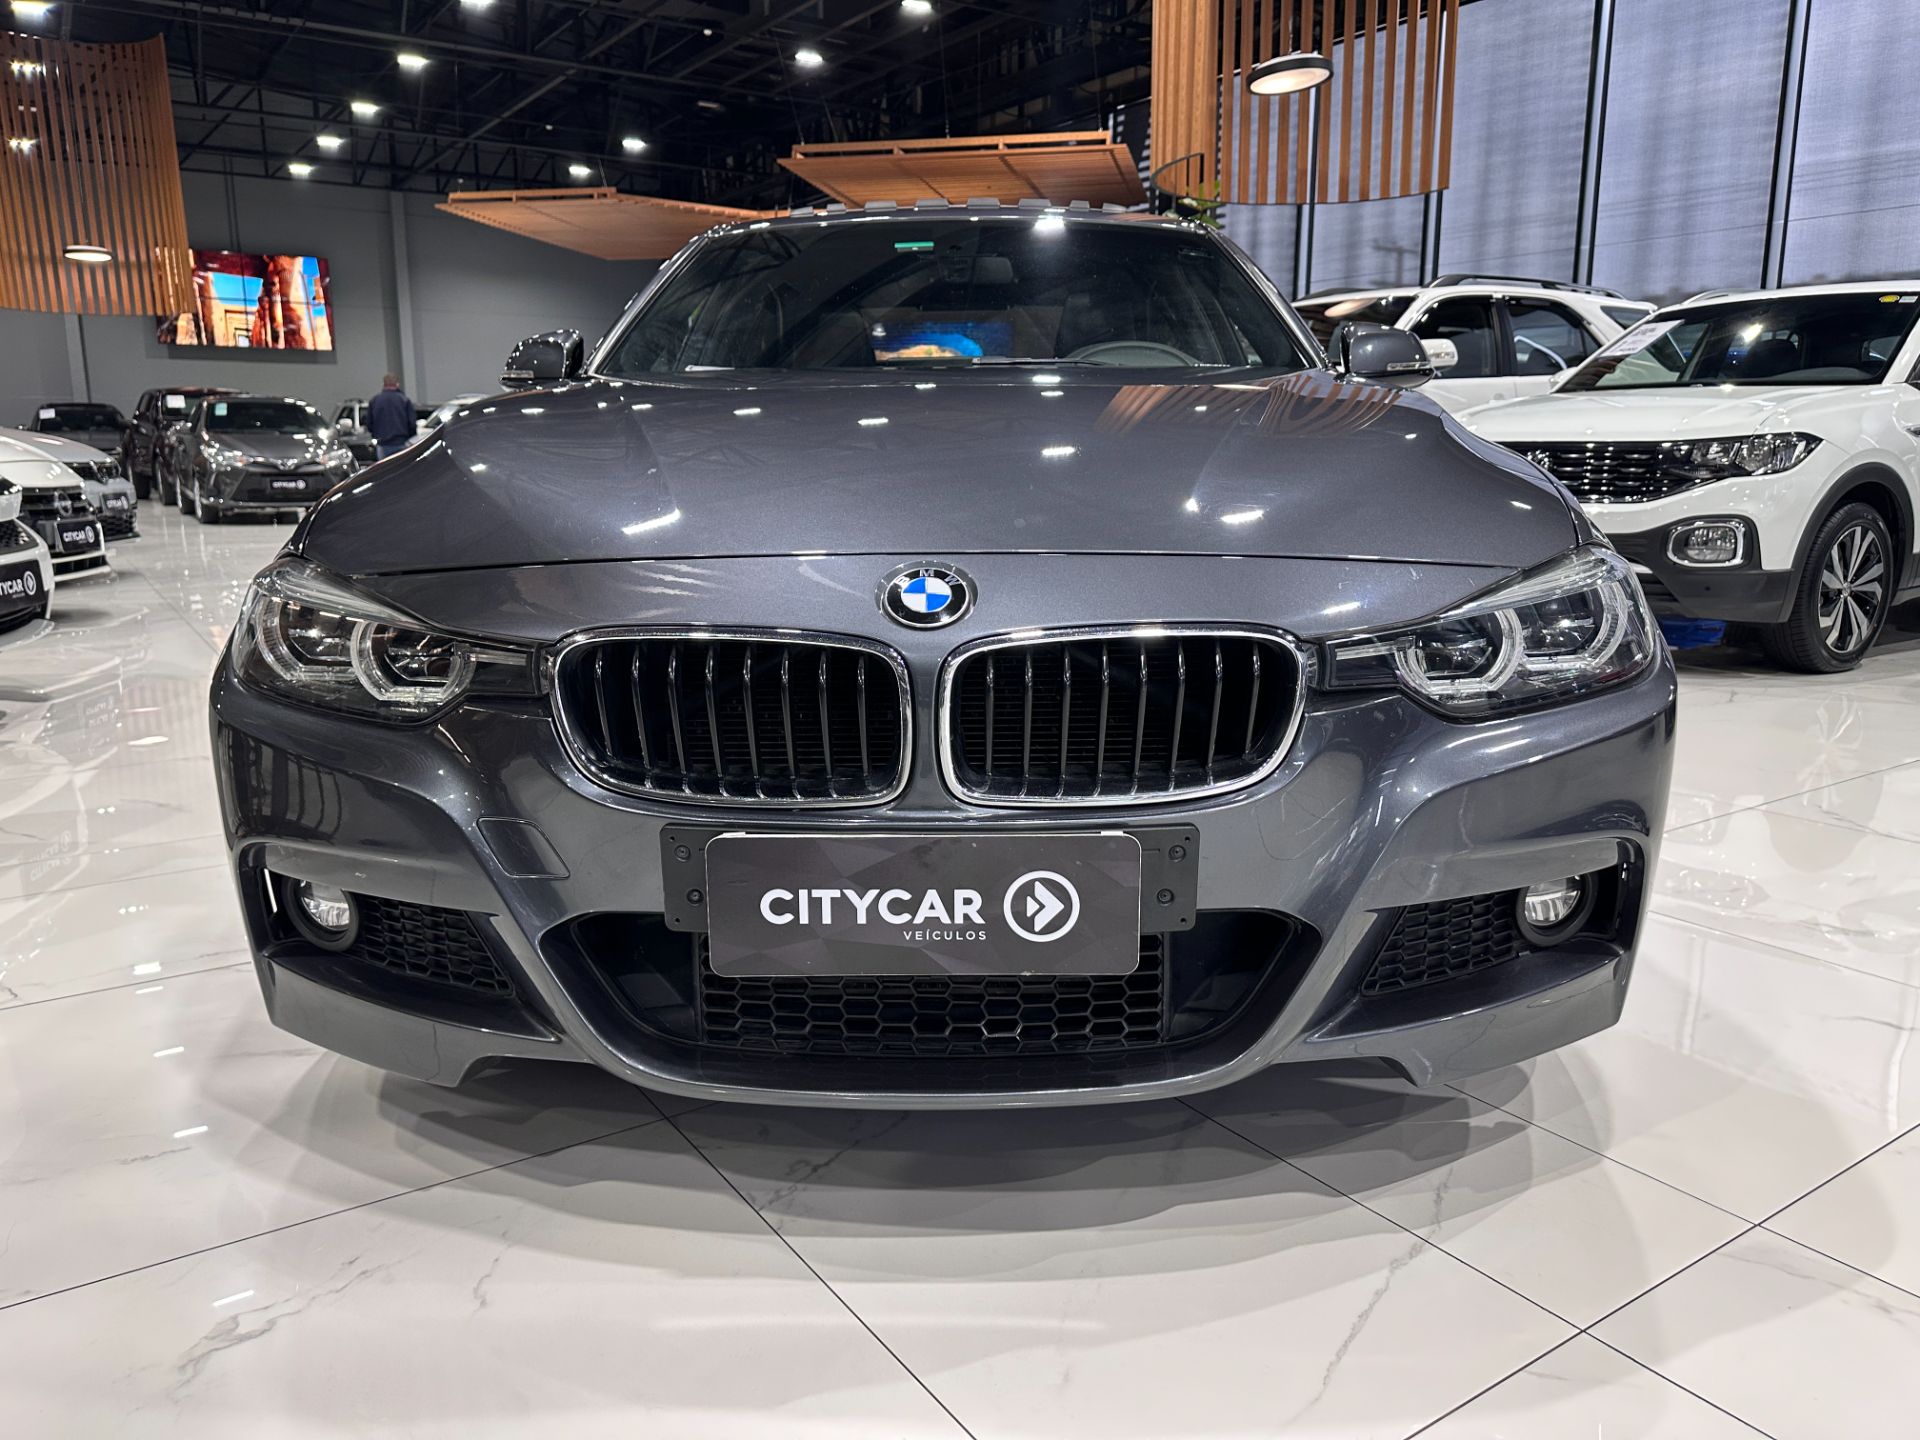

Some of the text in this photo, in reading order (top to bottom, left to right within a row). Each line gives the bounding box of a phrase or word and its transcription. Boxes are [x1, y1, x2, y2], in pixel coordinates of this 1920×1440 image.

[894, 568, 961, 586] BMW
[759, 888, 986, 925] CITYCAR
[903, 929, 987, 941] VEÍCULOS
